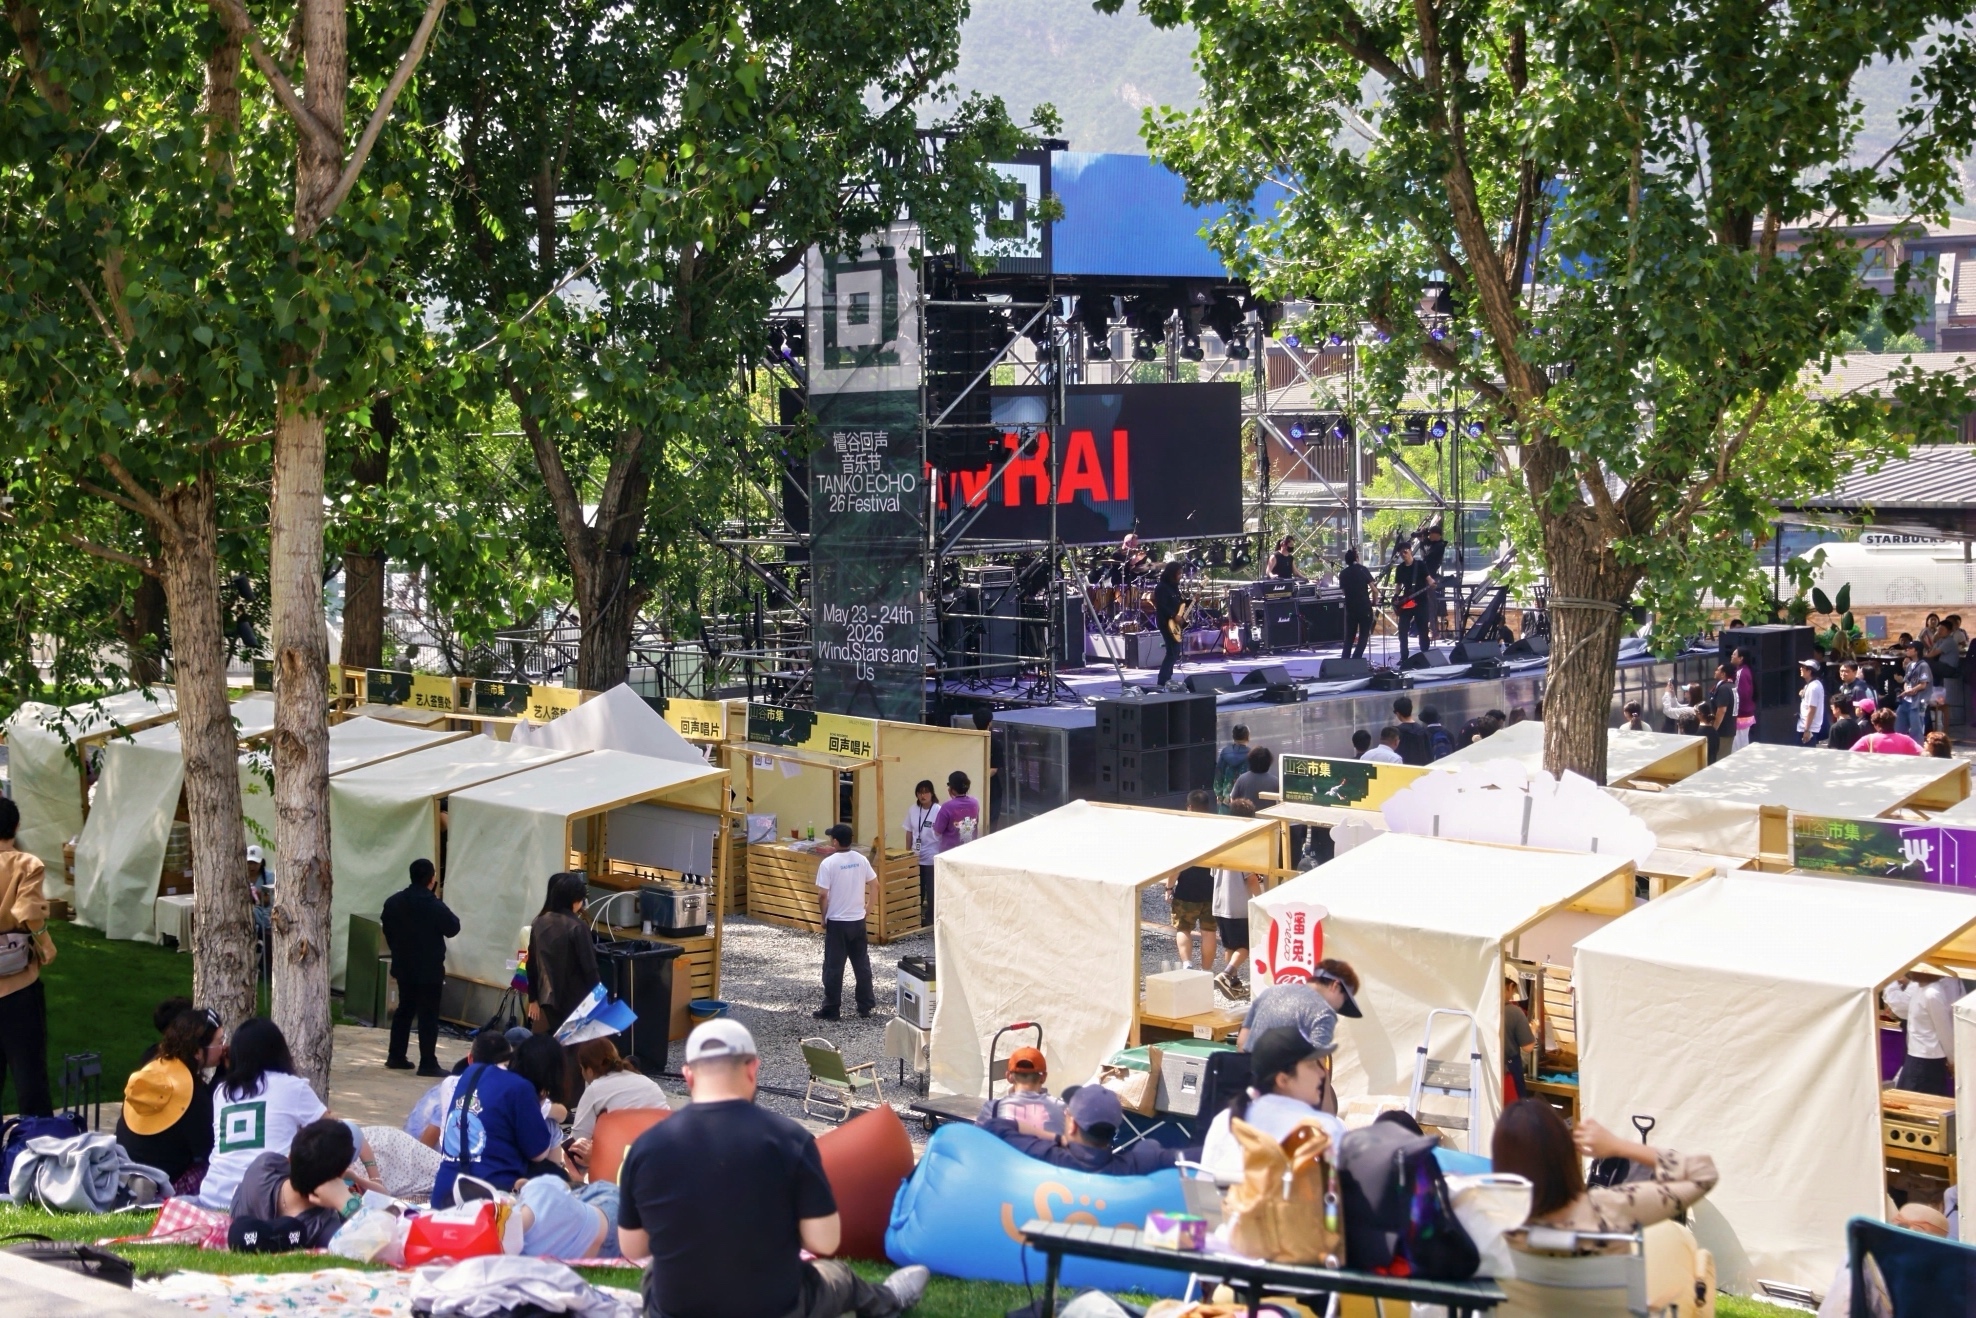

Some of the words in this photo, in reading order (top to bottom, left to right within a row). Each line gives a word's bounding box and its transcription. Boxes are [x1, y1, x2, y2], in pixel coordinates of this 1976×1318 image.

[833, 431, 889, 453] 檀谷回声
[842, 452, 882, 474] 音乐节
[816, 474, 863, 494] TANKO
[866, 473, 916, 493] ECHO
[829, 494, 846, 512] 26
[848, 493, 900, 512] Festival
[823, 603, 850, 626] May
[851, 605, 868, 624] 23
[880, 605, 914, 625] 24th
[846, 624, 884, 643] 2026
[818, 641, 889, 663] Wind,Stars
[892, 645, 919, 663] and
[856, 662, 875, 681] Us
[534, 704, 570, 720] 艺人签售
[750, 707, 785, 722] 山谷市集
[681, 720, 720, 738] 回声唱片
[829, 737, 871, 757] 回声唱片
[1284, 758, 1331, 777] 山谷市集
[1796, 818, 1860, 841] 山谷市集
